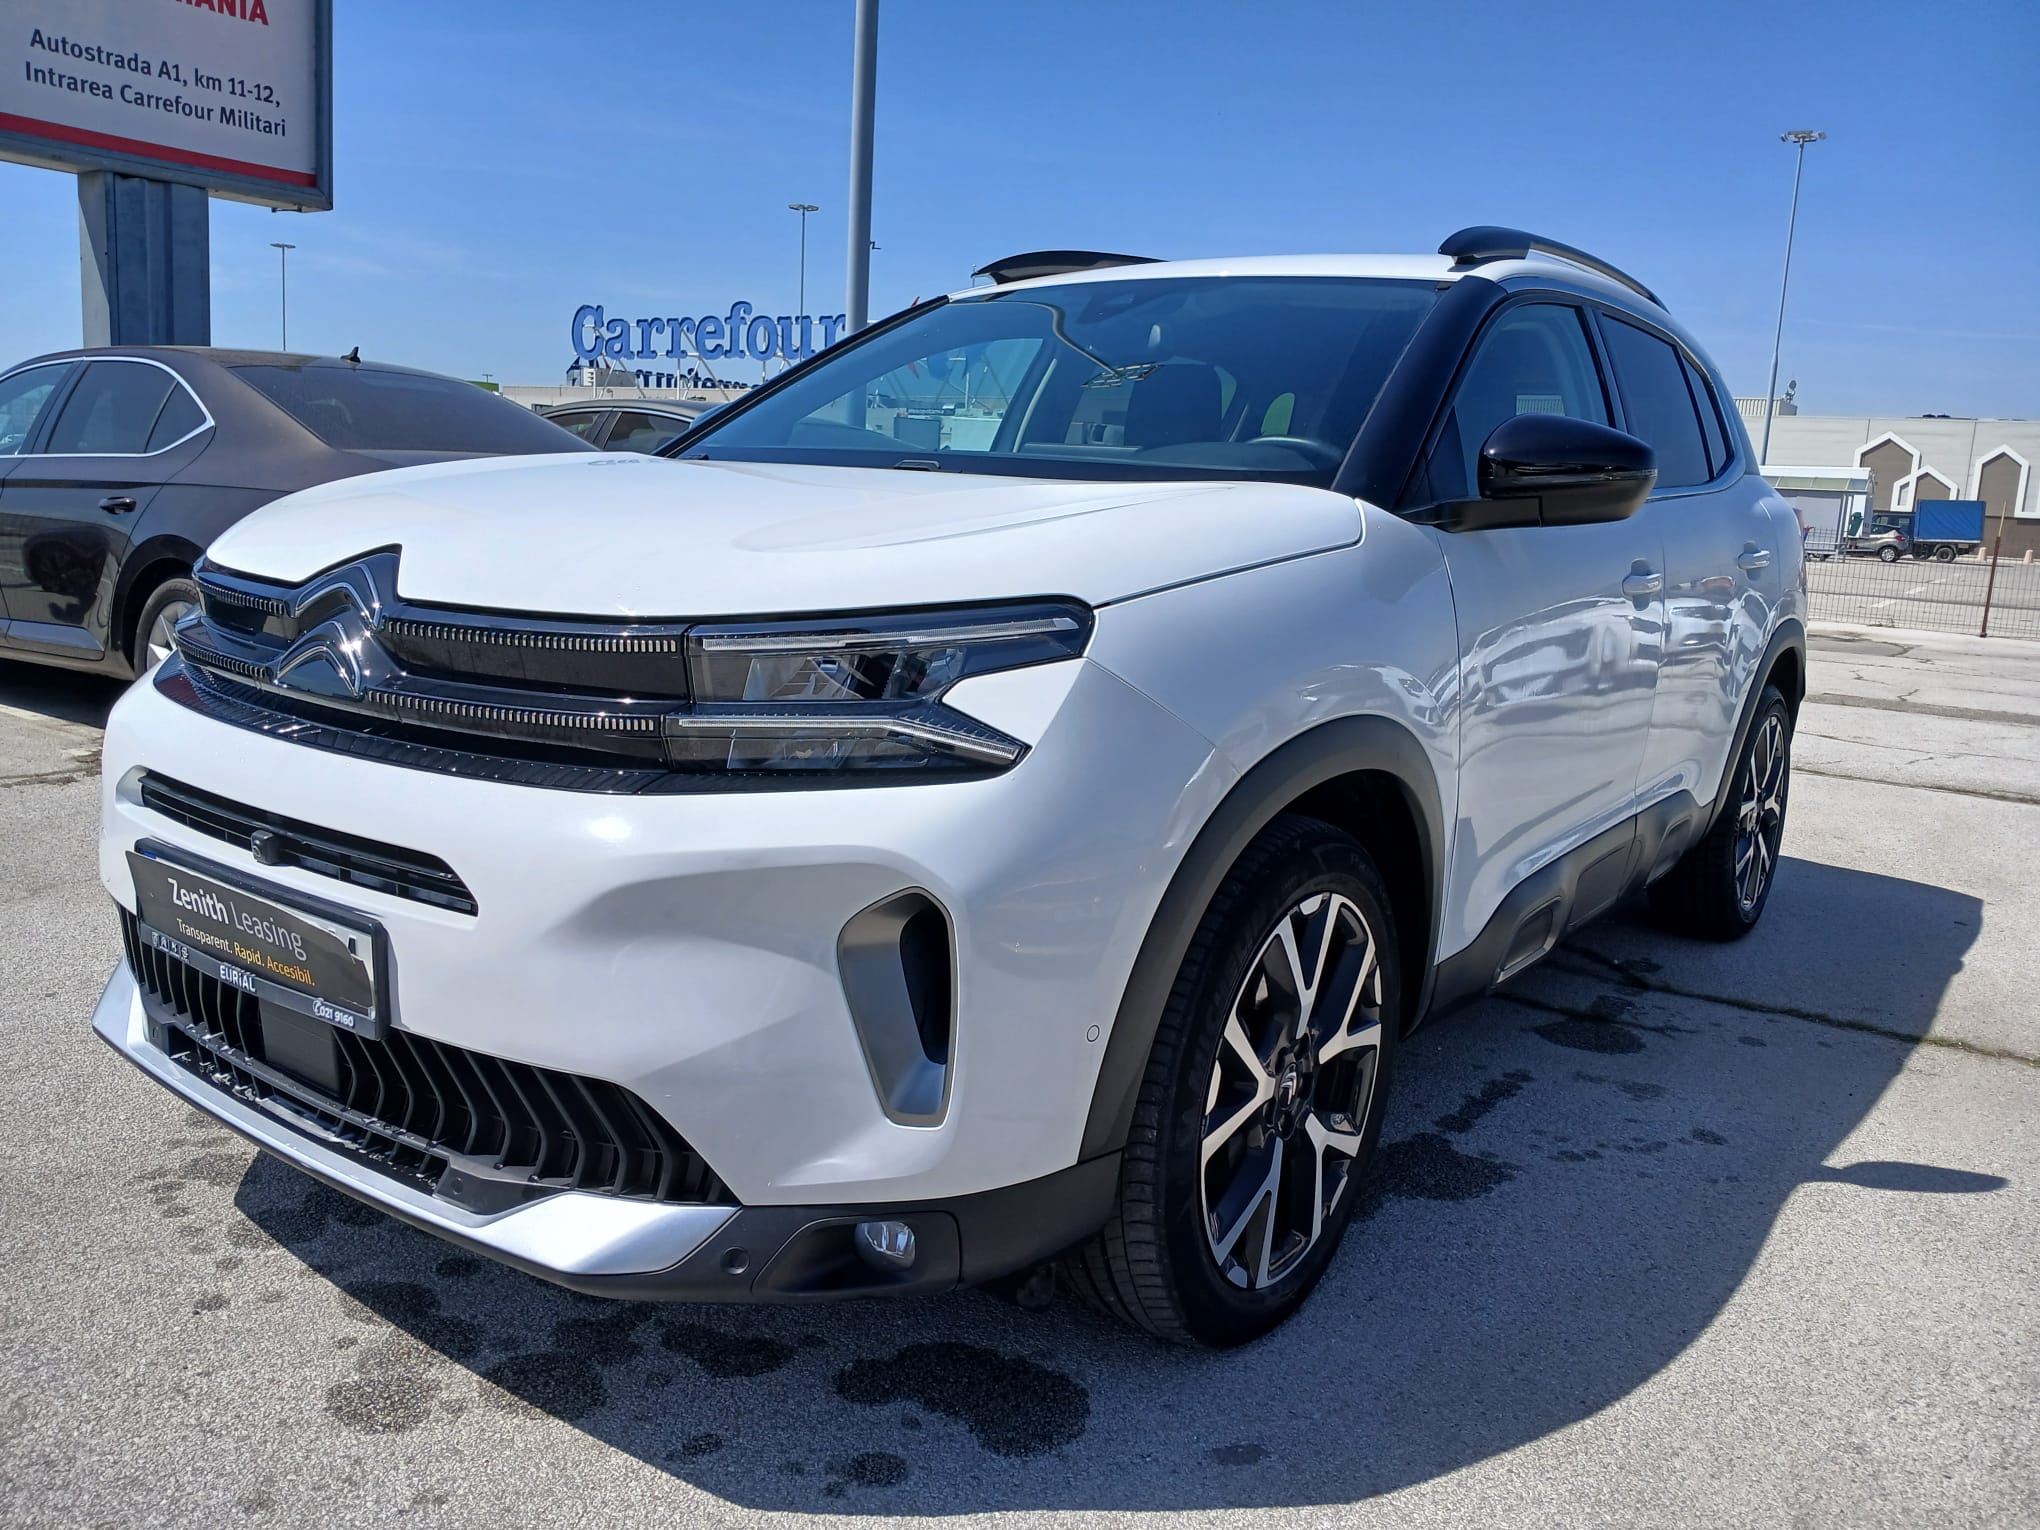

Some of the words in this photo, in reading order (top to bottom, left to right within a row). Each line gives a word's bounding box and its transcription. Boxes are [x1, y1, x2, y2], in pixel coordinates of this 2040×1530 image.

[25, 61, 113, 100] Intrarea
[120, 84, 214, 121] Carrefour
[219, 106, 286, 137] Militari
[30, 28, 152, 76] Autostrada
[158, 60, 188, 87] A1,
[194, 67, 222, 92] km
[228, 77, 281, 108] 11-12,
[571, 300, 846, 361] Carrefour
[167, 877, 229, 925] Zenith
[230, 902, 307, 961] Leasing
[176, 918, 233, 954] Transparent.
[234, 942, 265, 967] Rapid.
[267, 956, 316, 986] Accesibil.
[319, 1006, 333, 1019] 021
[334, 1011, 354, 1027] 9160
